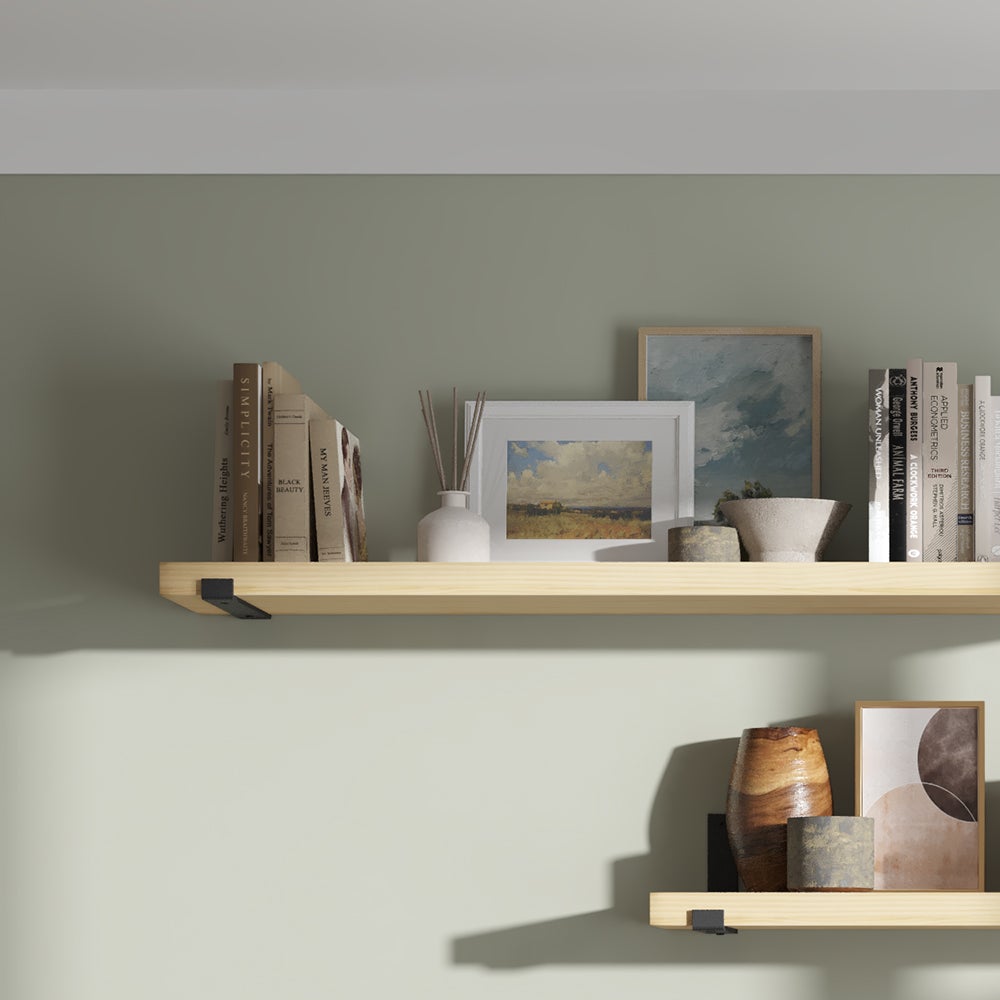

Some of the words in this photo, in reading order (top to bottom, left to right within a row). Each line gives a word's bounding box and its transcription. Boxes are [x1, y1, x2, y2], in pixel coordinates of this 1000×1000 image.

[874, 387, 884, 426] WOMAN
[890, 396, 904, 417] George
[910, 376, 918, 410] ANTHONY
[240, 377, 250, 478] SIMPLICITY
[892, 418, 904, 437] Orwell
[910, 412, 918, 441] BURGESS
[930, 395, 939, 461] ECONOMETRICS
[940, 395, 949, 430] APPLIED
[960, 411, 970, 457] BUSINESS
[320, 448, 328, 461] MY
[892, 445, 906, 477] ANIMAL
[219, 457, 231, 493] Heights
[321, 464, 329, 484] MAN
[892, 479, 905, 500] FARM
[909, 462, 918, 508] CLOCKWORK
[960, 459, 970, 510] RESEARCH
[322, 486, 332, 517] JEEVES
[218, 496, 230, 543] Wuthering
[909, 510, 918, 539] ORANGE
